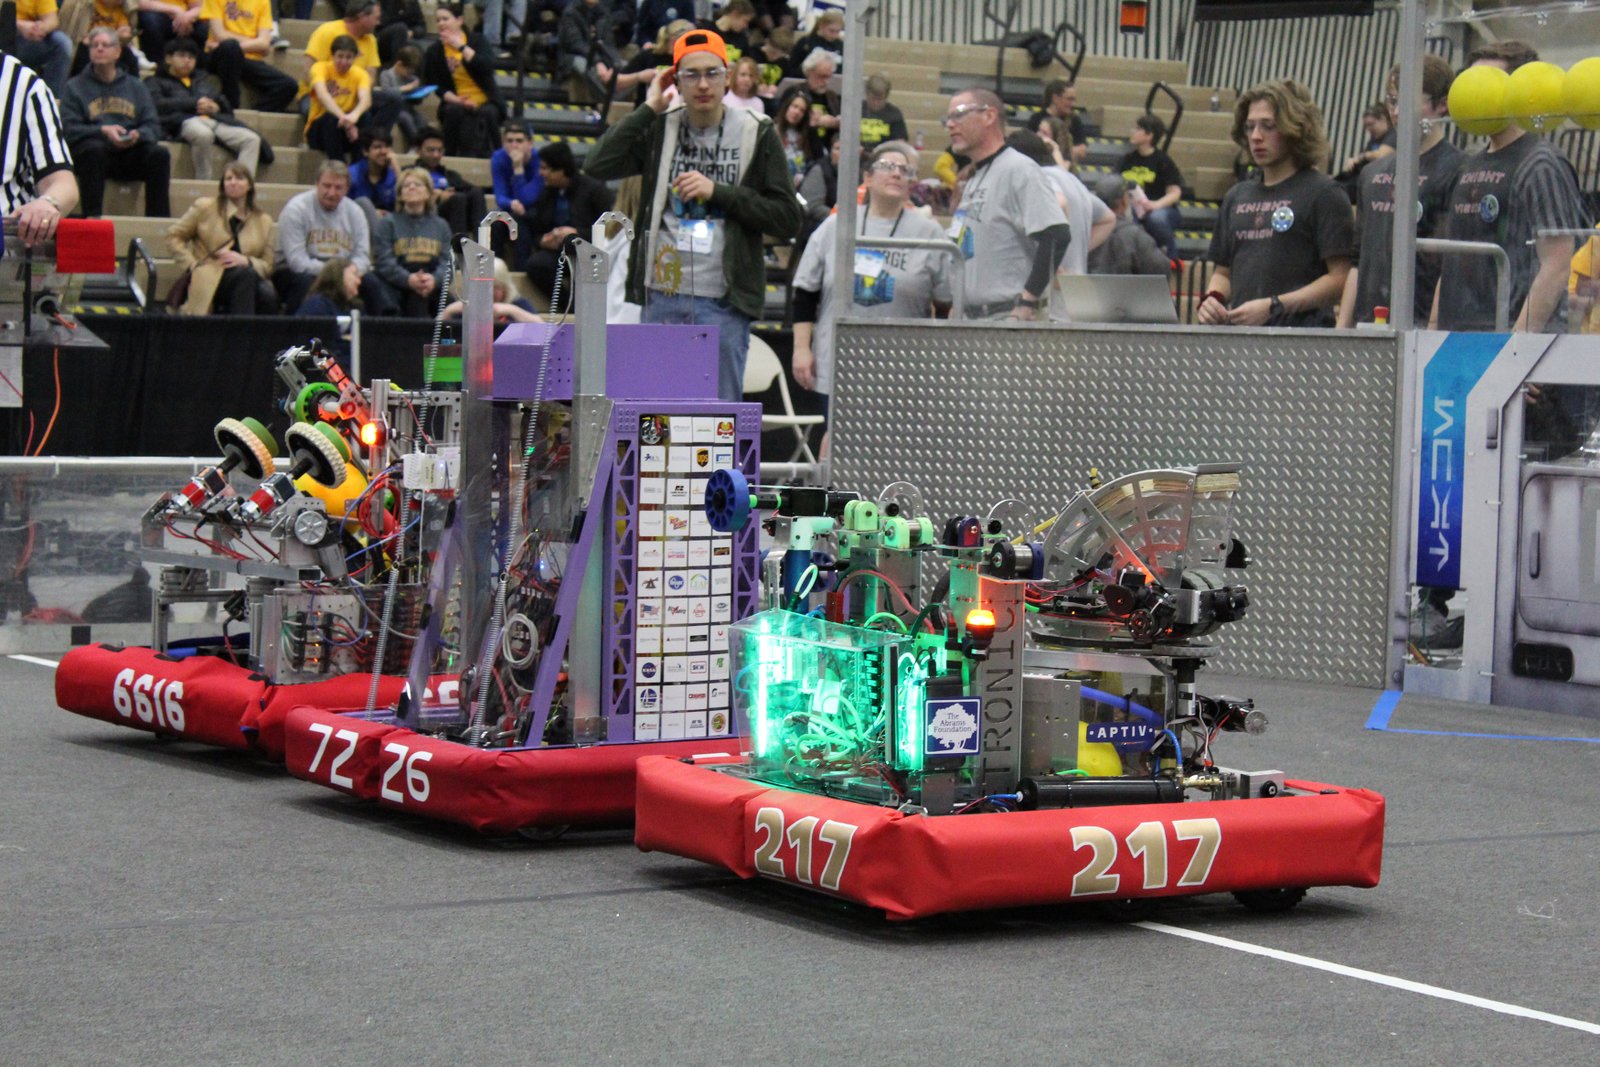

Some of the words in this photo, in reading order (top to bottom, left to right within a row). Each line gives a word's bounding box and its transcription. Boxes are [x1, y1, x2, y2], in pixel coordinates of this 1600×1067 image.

[113, 668, 185, 732] 6616
[947, 712, 960, 720] The
[1097, 725, 1147, 738] APTIV
[754, 807, 858, 891] 217
[1069, 817, 1222, 897] 217
